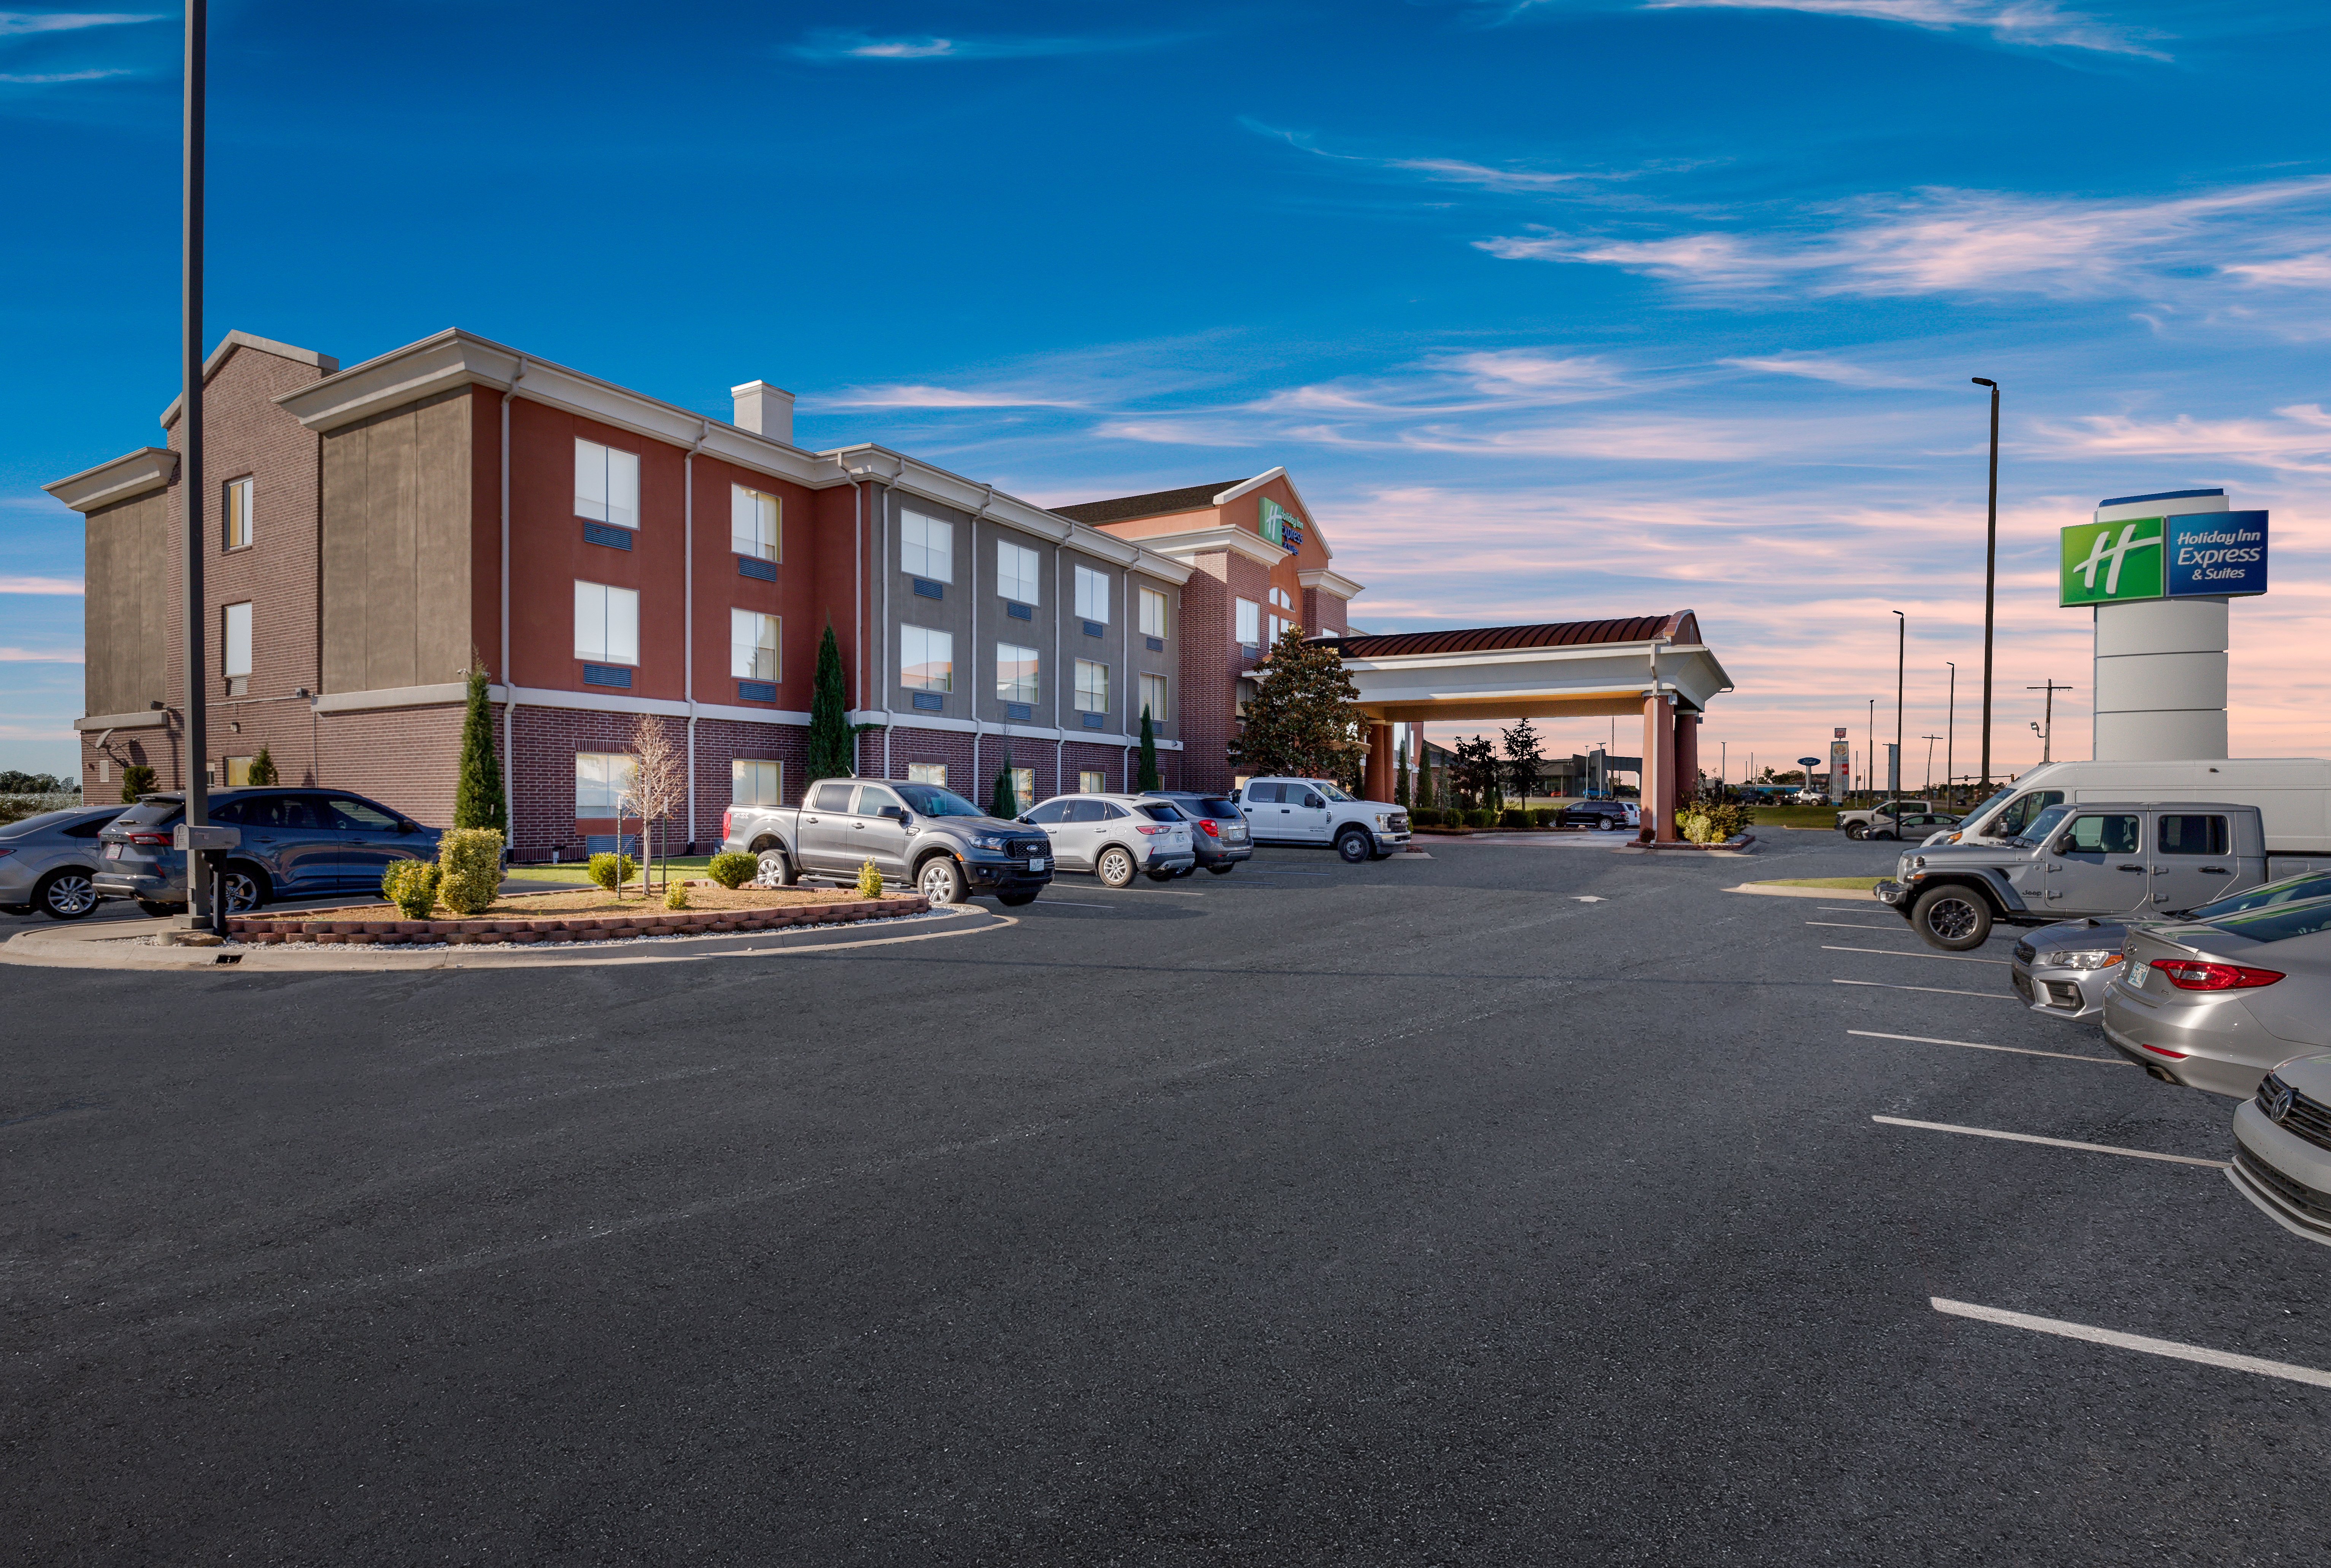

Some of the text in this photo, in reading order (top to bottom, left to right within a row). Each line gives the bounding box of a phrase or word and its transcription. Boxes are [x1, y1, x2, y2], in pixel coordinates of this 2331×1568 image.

[2177, 529, 2261, 545] Holiday Inn
[2177, 547, 2260, 568] Express
[2192, 567, 2245, 580] & Suites
